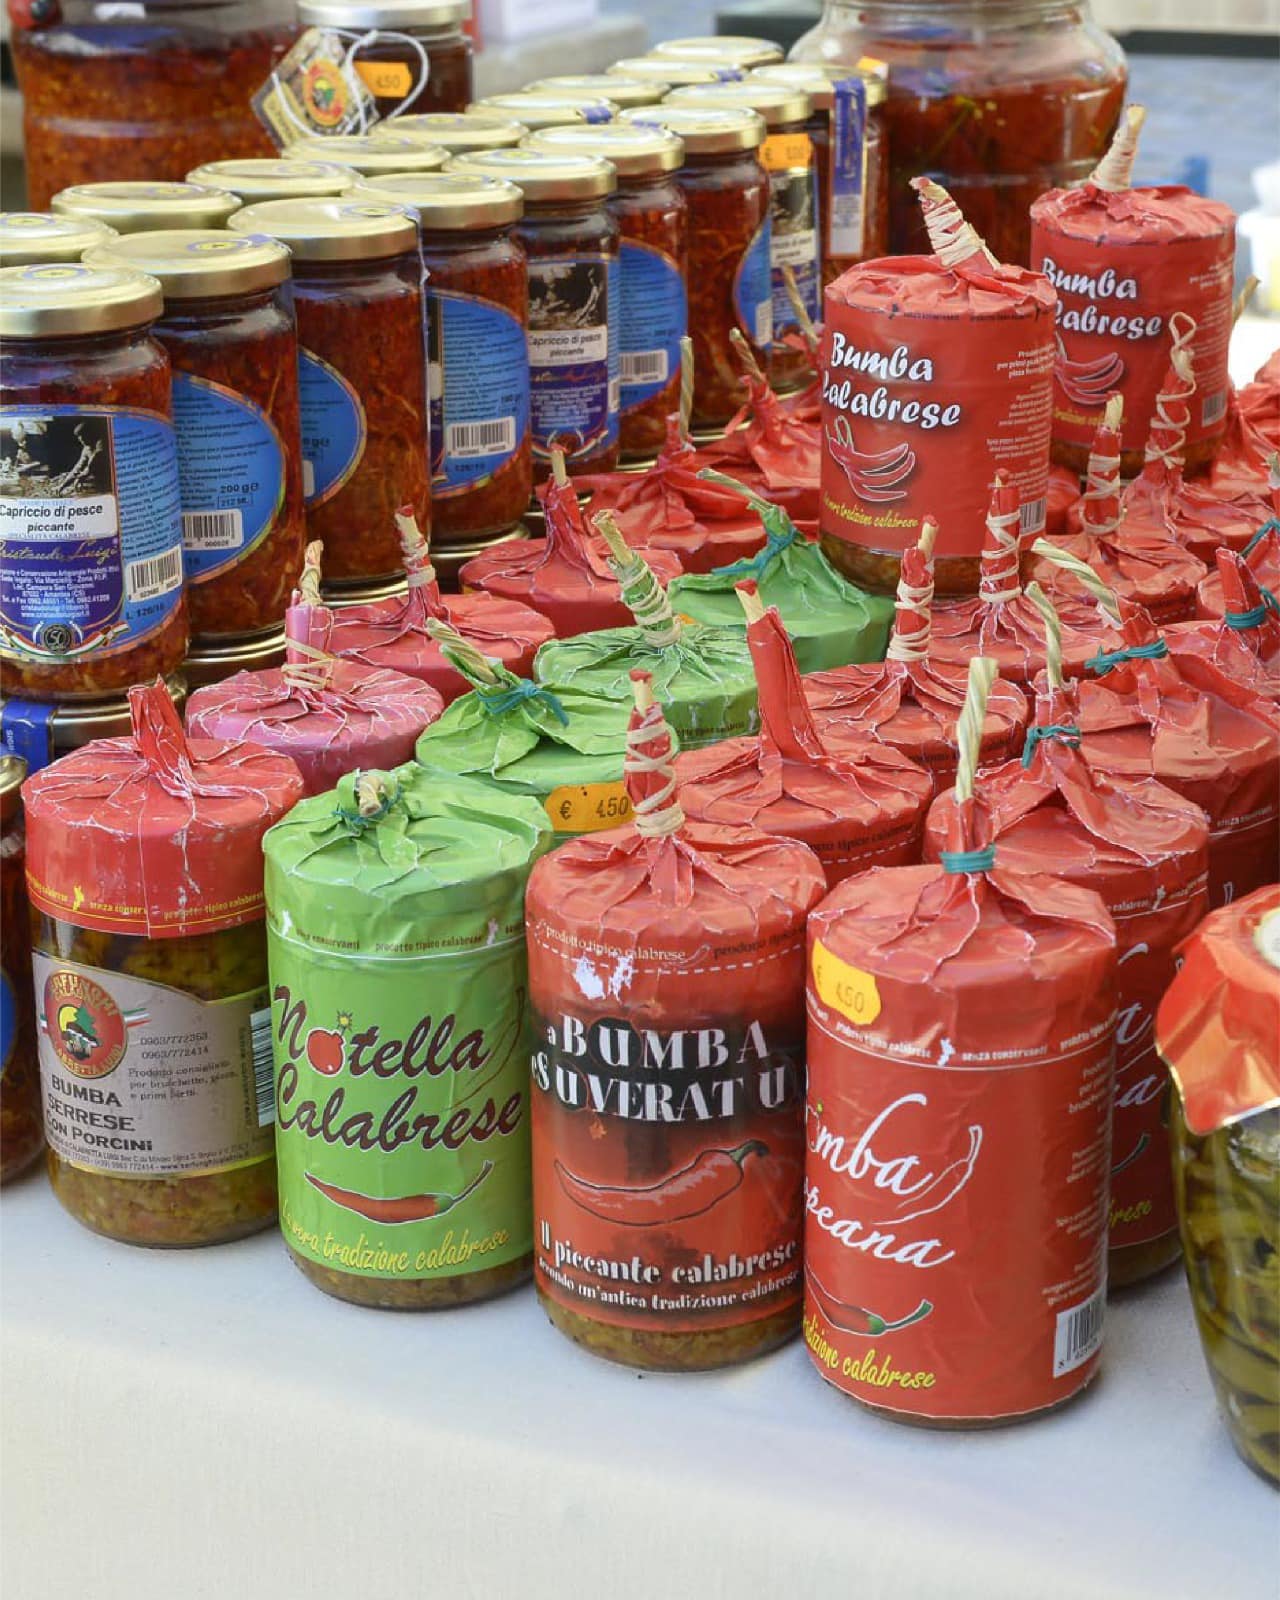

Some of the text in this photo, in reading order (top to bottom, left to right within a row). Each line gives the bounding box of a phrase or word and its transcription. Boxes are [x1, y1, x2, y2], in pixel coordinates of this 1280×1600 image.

[831, 332, 934, 382] Bumba
[0, 504, 103, 520] Capriccio di pesce
[27, 522, 76, 534] piccante
[560, 796, 629, 820] € 450
[560, 1013, 770, 1070] BUMBA
[51, 1074, 122, 1108] BUMBA
[277, 1062, 523, 1153] Calabrese
[48, 1094, 136, 1132] SERRESE
[72, 1127, 153, 1152] PORCINI
[323, 1231, 410, 1273] tradizione
[415, 1228, 510, 1272] calabrese
[541, 1220, 796, 1285] Il piccante calabrese
[578, 1286, 647, 1309] un'antica
[651, 1292, 738, 1311] tradizione
[742, 1269, 798, 1302] calabrese
[842, 1348, 937, 1389] calabrese
